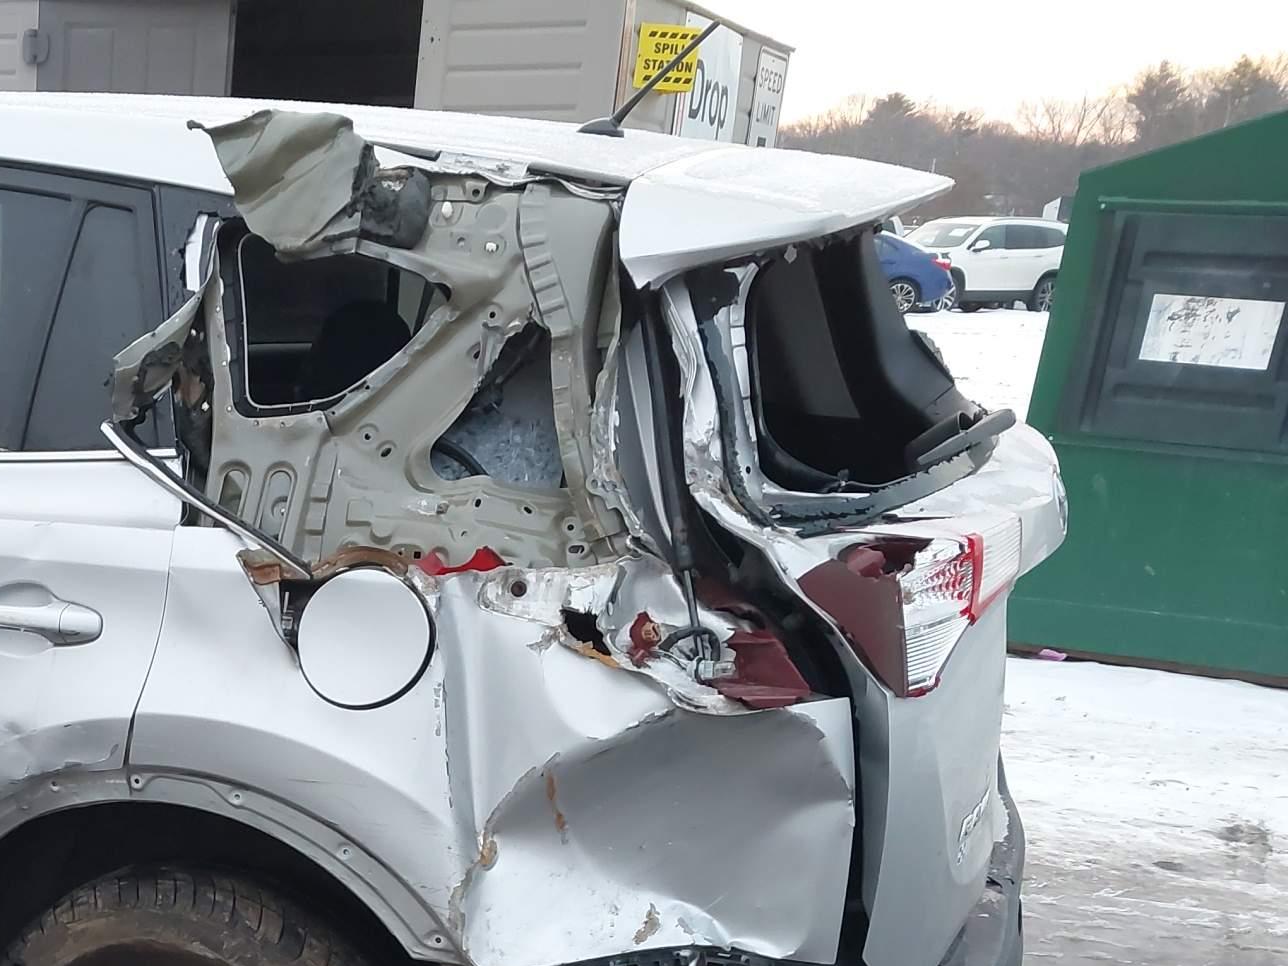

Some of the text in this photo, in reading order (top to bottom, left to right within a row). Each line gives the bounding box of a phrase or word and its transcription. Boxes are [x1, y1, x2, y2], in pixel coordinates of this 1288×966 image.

[759, 66, 783, 94] SPEED
[688, 59, 729, 140] Drop
[756, 101, 776, 126] LIMIT
